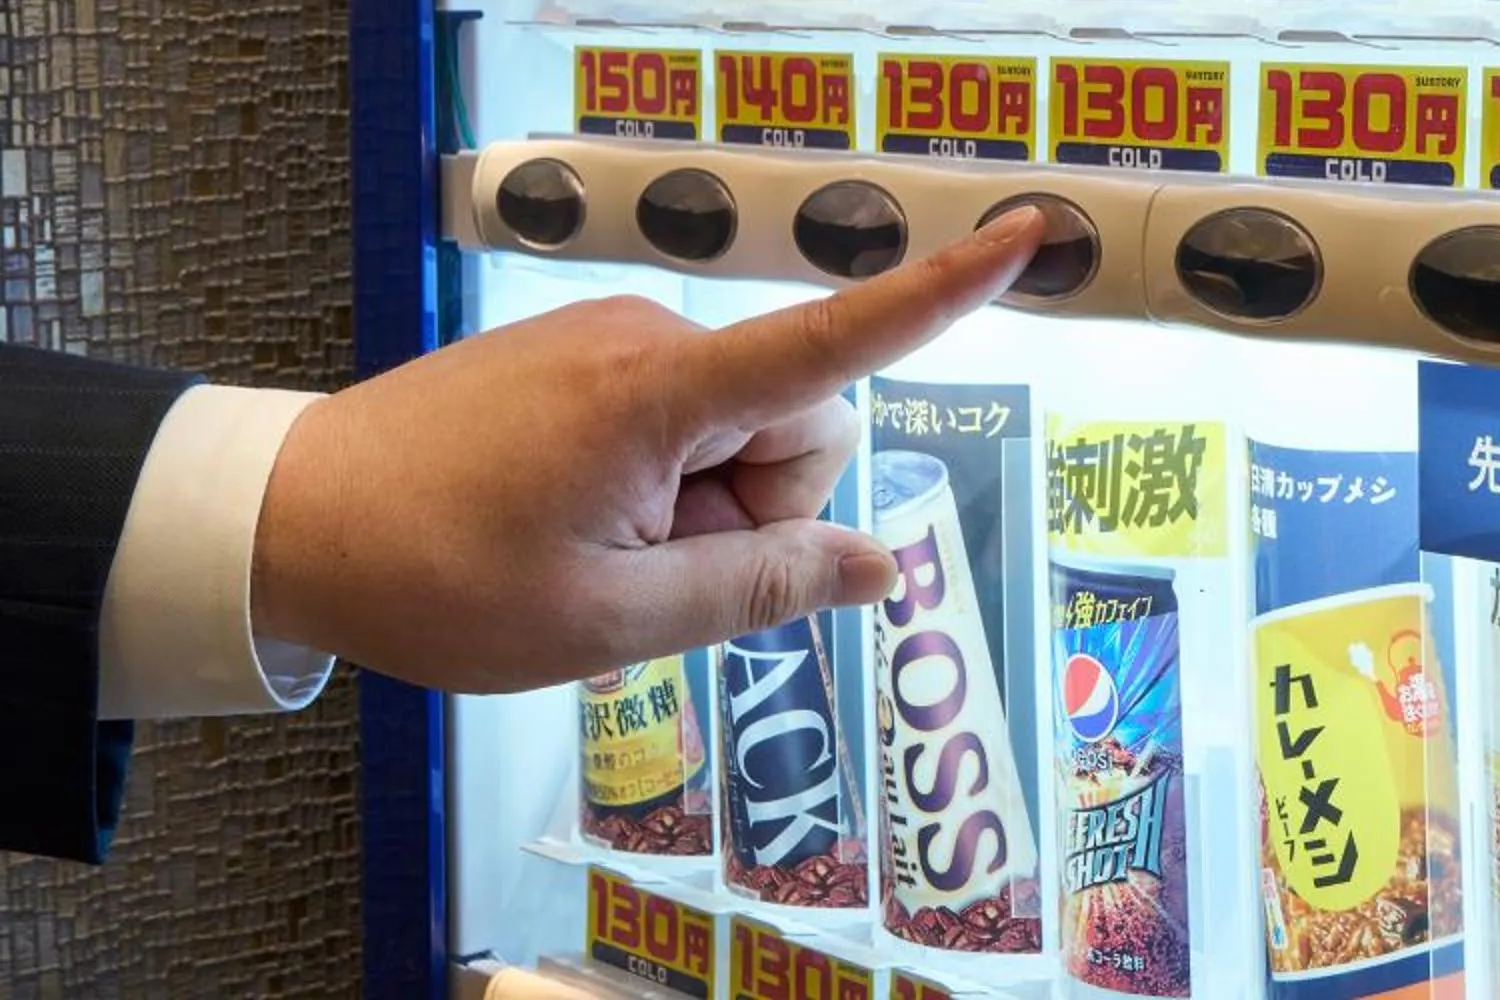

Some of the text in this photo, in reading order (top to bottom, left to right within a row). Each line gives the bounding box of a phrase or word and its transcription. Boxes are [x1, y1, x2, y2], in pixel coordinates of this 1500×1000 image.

[579, 50, 697, 117] 150円
[718, 54, 849, 125] 140円
[882, 59, 1031, 135] 130円
[1056, 64, 1223, 144] 130円
[1415, 75, 1462, 89] SUNTORY
[615, 119, 655, 139] COLD
[1267, 70, 1459, 156] 130円
[762, 127, 805, 148] COLD
[928, 137, 977, 159] COLD
[1108, 147, 1162, 169] COLD
[1324, 157, 1388, 184] COLD
[883, 523, 1008, 892] BOSS
[591, 873, 710, 978] 130円
[626, 955, 669, 985] COLD
